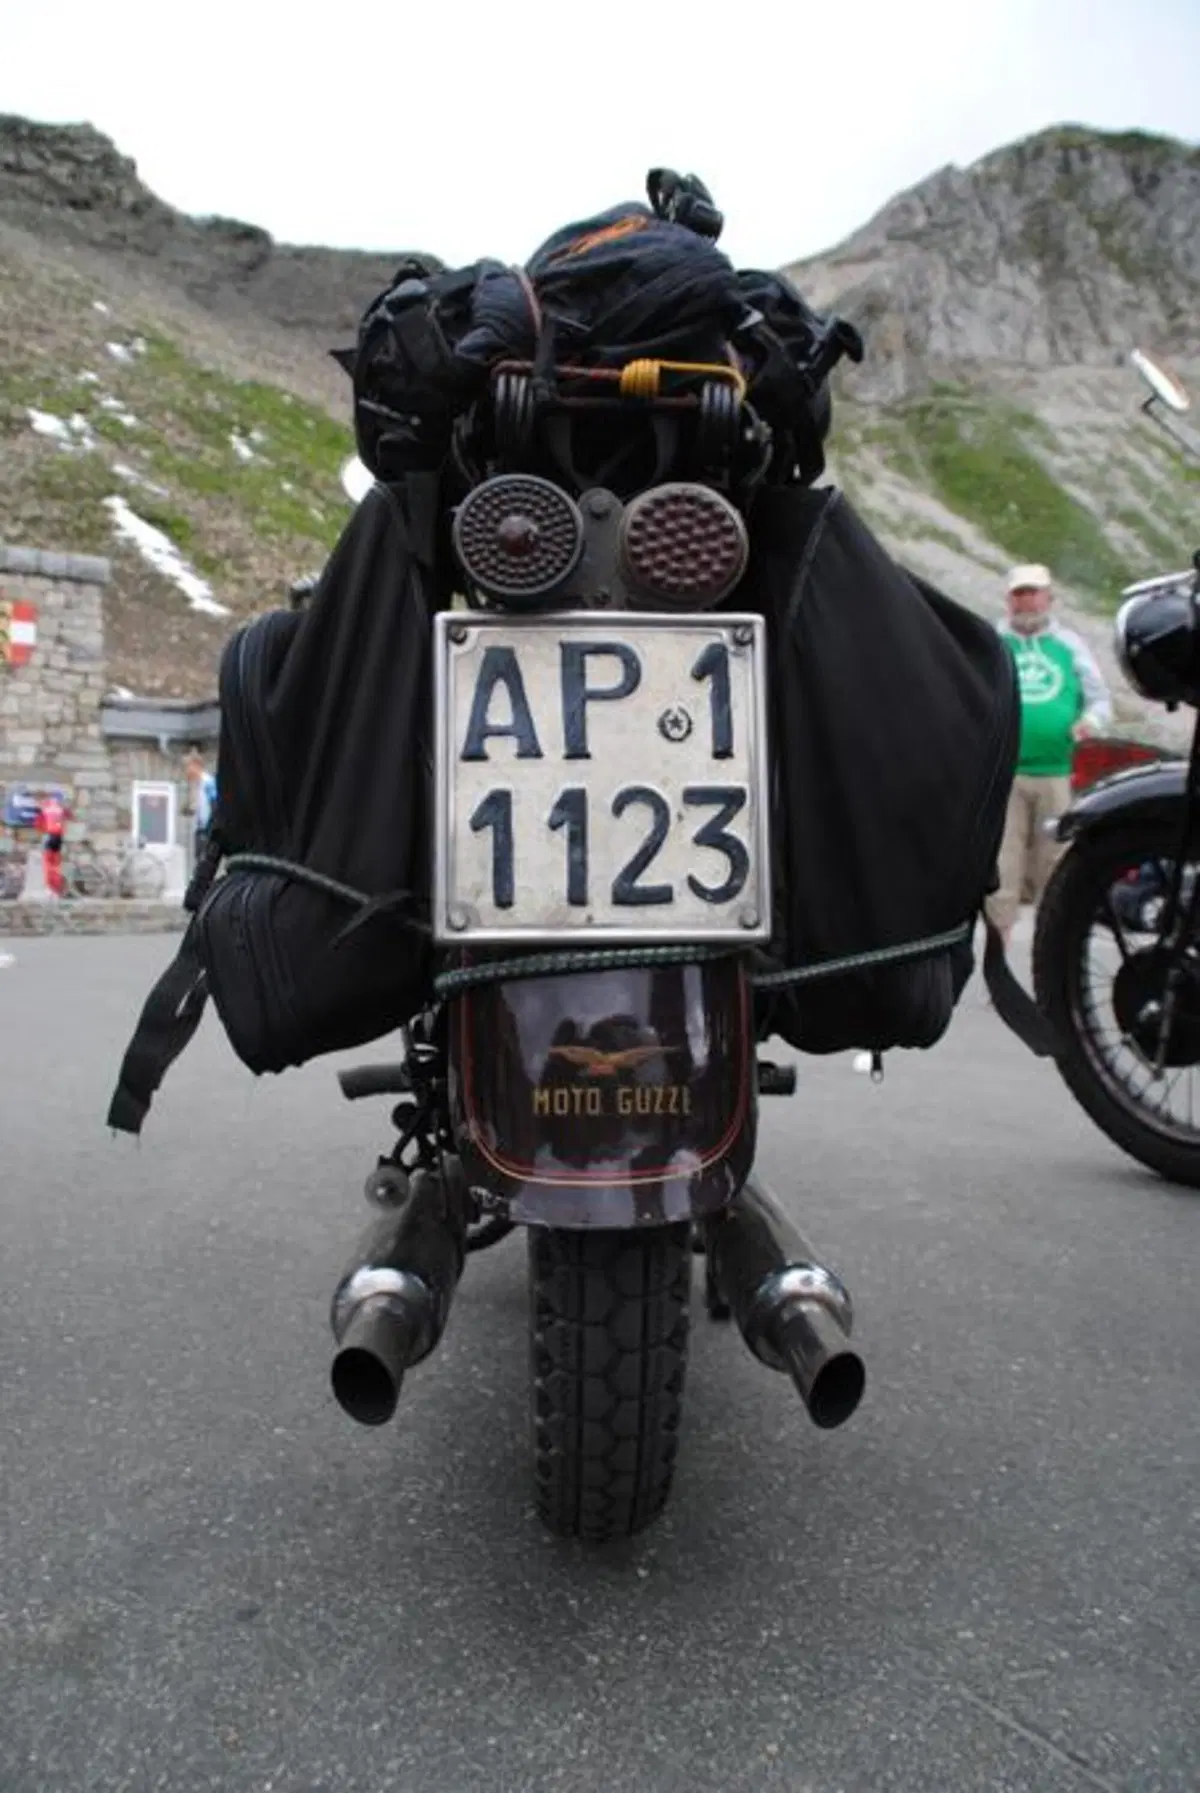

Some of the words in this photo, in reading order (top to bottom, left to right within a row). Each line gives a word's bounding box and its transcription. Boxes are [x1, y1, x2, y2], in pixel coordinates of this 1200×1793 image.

[460, 641, 642, 761] AP
[691, 642, 734, 760] 1
[469, 786, 750, 909] 1123
[533, 1086, 601, 1116] MOTO
[617, 1086, 692, 1116] GUZZI
